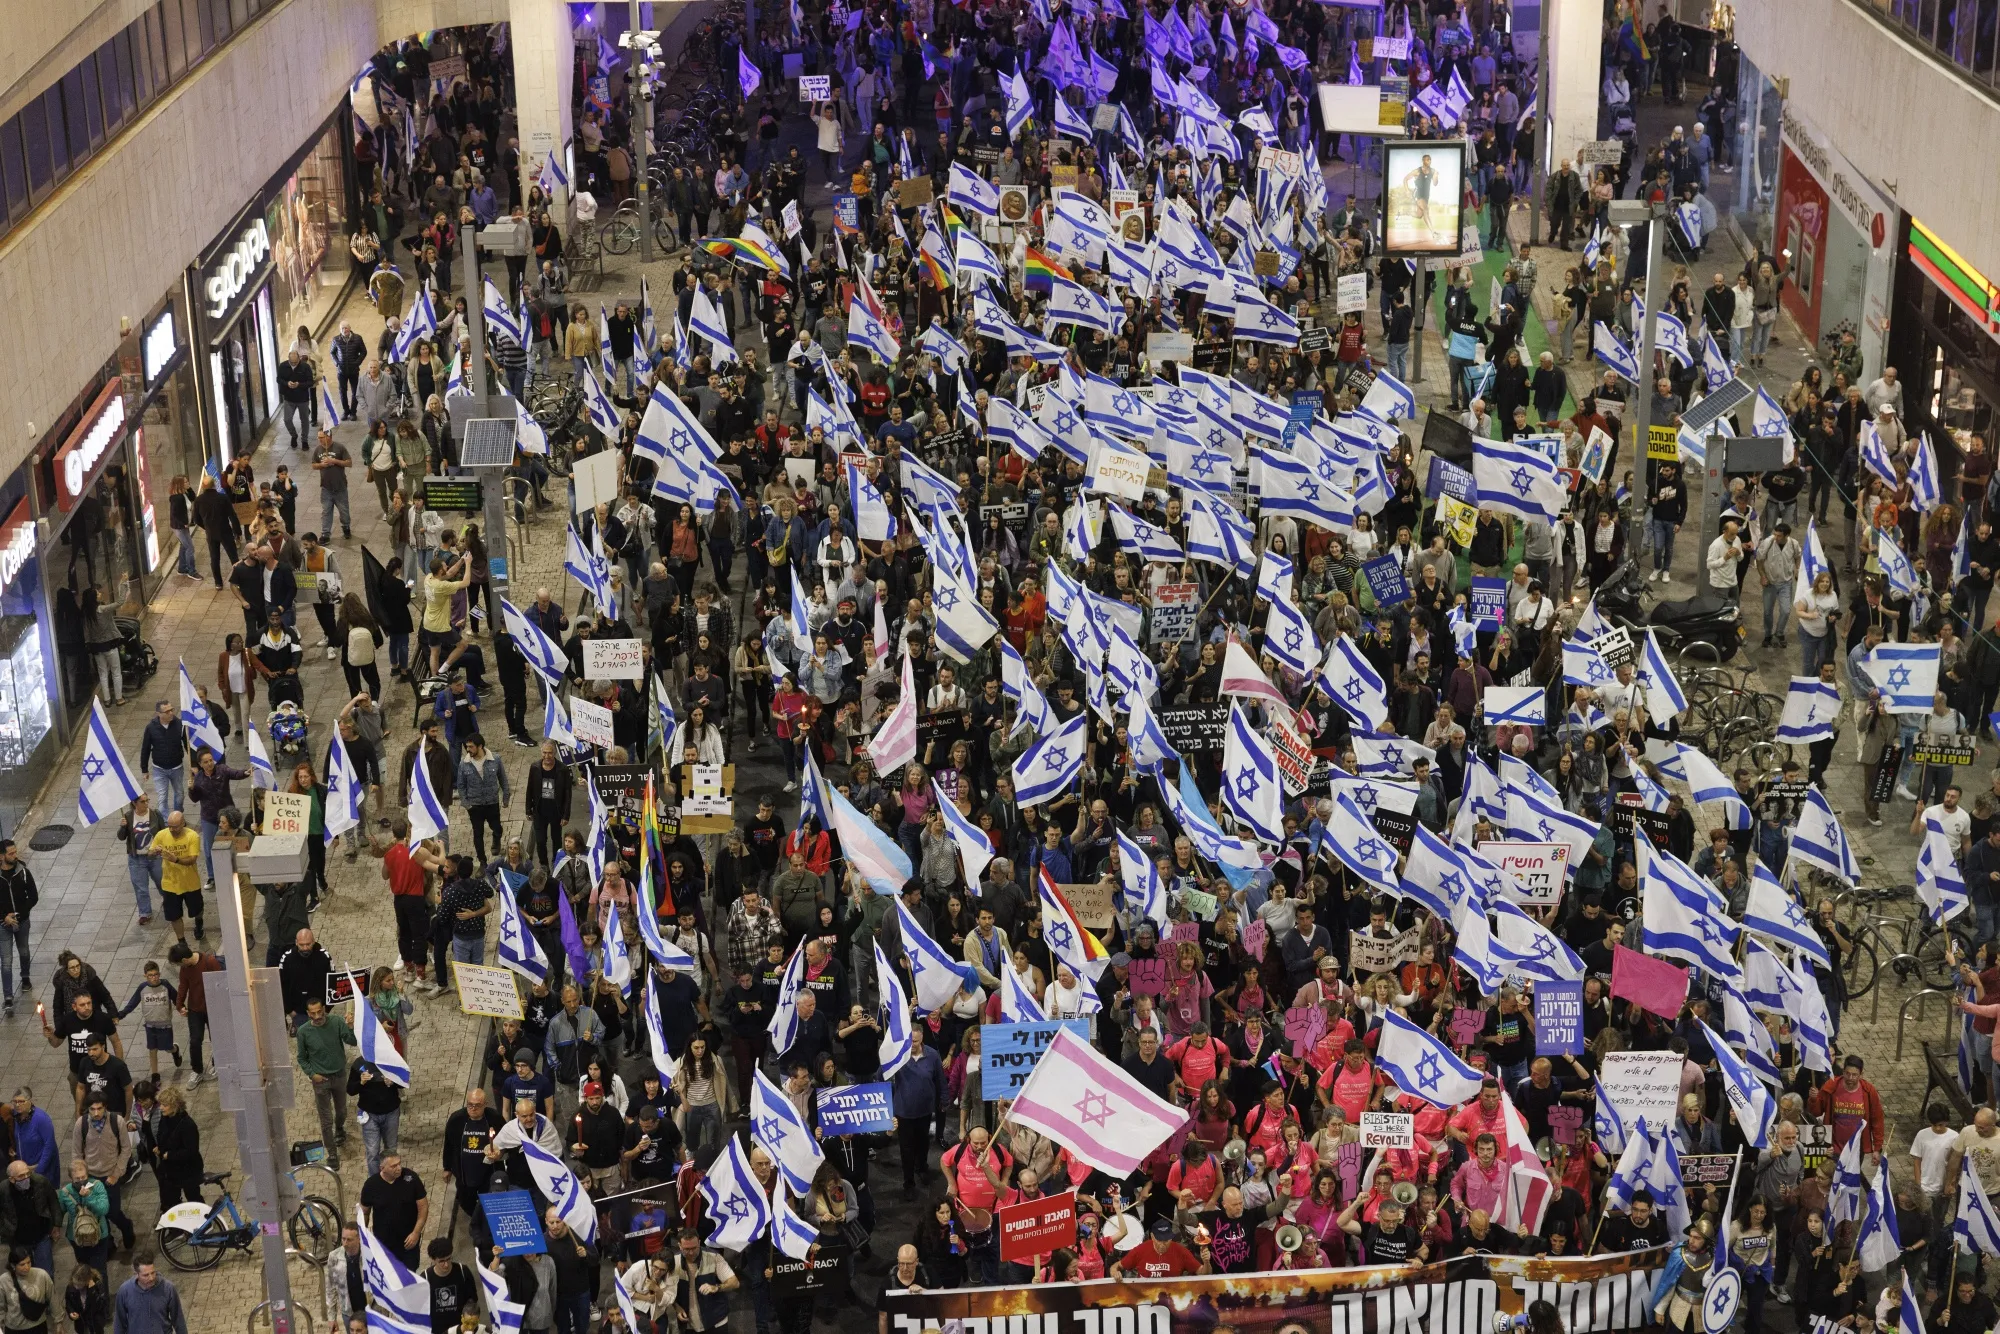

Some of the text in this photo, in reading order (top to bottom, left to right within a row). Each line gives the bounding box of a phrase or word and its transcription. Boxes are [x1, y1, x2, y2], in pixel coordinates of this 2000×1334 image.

[205, 217, 272, 319] SACARA
[1444, 257, 1476, 269] Despair
[1460, 323, 1476, 331] Wolt
[2, 521, 36, 584] Center
[1472, 593, 1504, 605] דמוקרטיה
[1474, 605, 1491, 615] מלא.
[1162, 705, 1228, 726] לא אשתוק
[1199, 723, 1227, 735] ארצי
[1177, 738, 1202, 750] פניה
[1916, 753, 1971, 765] שופטים
[598, 773, 632, 783] לבטחון
[276, 809, 301, 818] C'est
[1376, 817, 1411, 831] לבטחון
[1616, 812, 1668, 830] השר לבחון
[1528, 874, 1550, 886] רק
[1245, 923, 1262, 935] PINK
[1244, 930, 1265, 946] FRONT
[1540, 992, 1576, 1001] נלחמנו למען
[1537, 1002, 1580, 1019] המדינה,
[1540, 1018, 1577, 1027] עכשיו נילחם
[1013, 1030, 1030, 1045] לי
[1544, 1028, 1575, 1043] עליה.
[832, 1091, 887, 1108] אני ימני
[821, 1107, 891, 1126] דמוקרטי!
[1363, 1113, 1410, 1124] BIBISTAN
[1366, 1133, 1410, 1146] REVOLT!!!
[632, 1198, 667, 1206] DEMOCRACY
[500, 1214, 526, 1222] אנחנו
[1005, 1208, 1071, 1233] מאבק הנשים
[498, 1221, 531, 1230] המחנה
[496, 1228, 537, 1239] המשותף
[1331, 1268, 1664, 1334] אתמול חווארה
